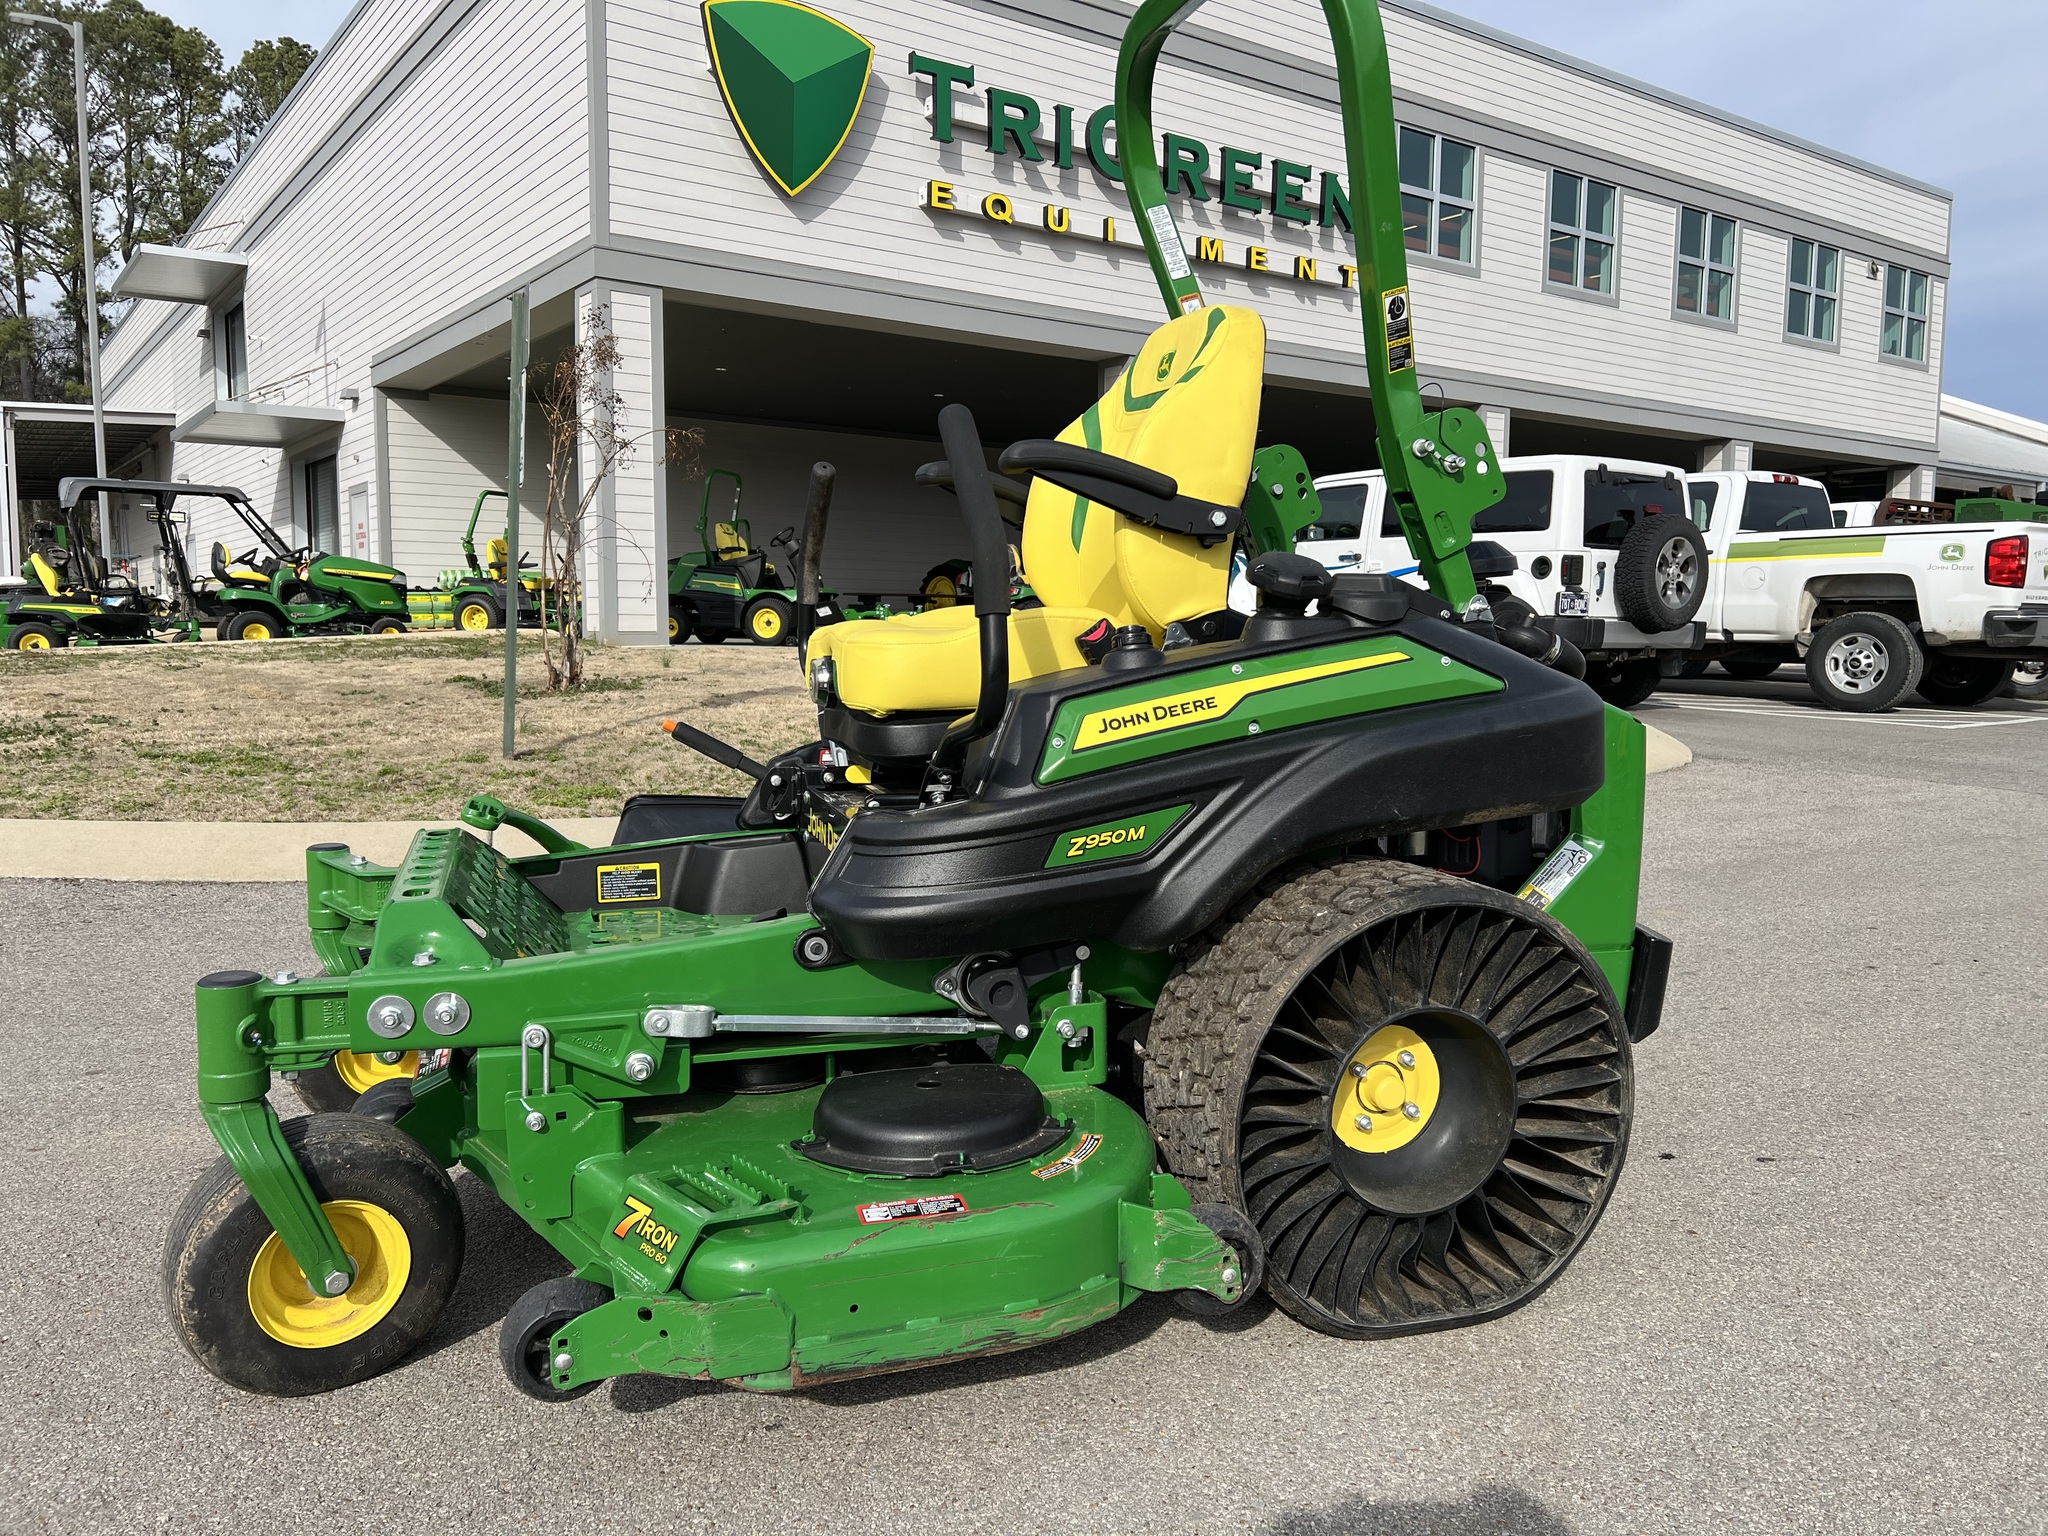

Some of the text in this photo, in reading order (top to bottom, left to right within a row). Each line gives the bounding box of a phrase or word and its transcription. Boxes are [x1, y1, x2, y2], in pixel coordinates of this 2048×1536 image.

[926, 180, 1358, 288] EQUIMENT
[1926, 563, 1975, 571] JOHN DEERE
[1098, 696, 1218, 734] JOHN DEERE
[808, 807, 827, 847] JOHN
[1066, 825, 1147, 858] Z950M
[925, 1194, 955, 1202] PELIGRO
[613, 1194, 679, 1254] 7 IRON
[209, 1208, 261, 1300] CARLIS
[639, 1242, 667, 1265] PRO 60
